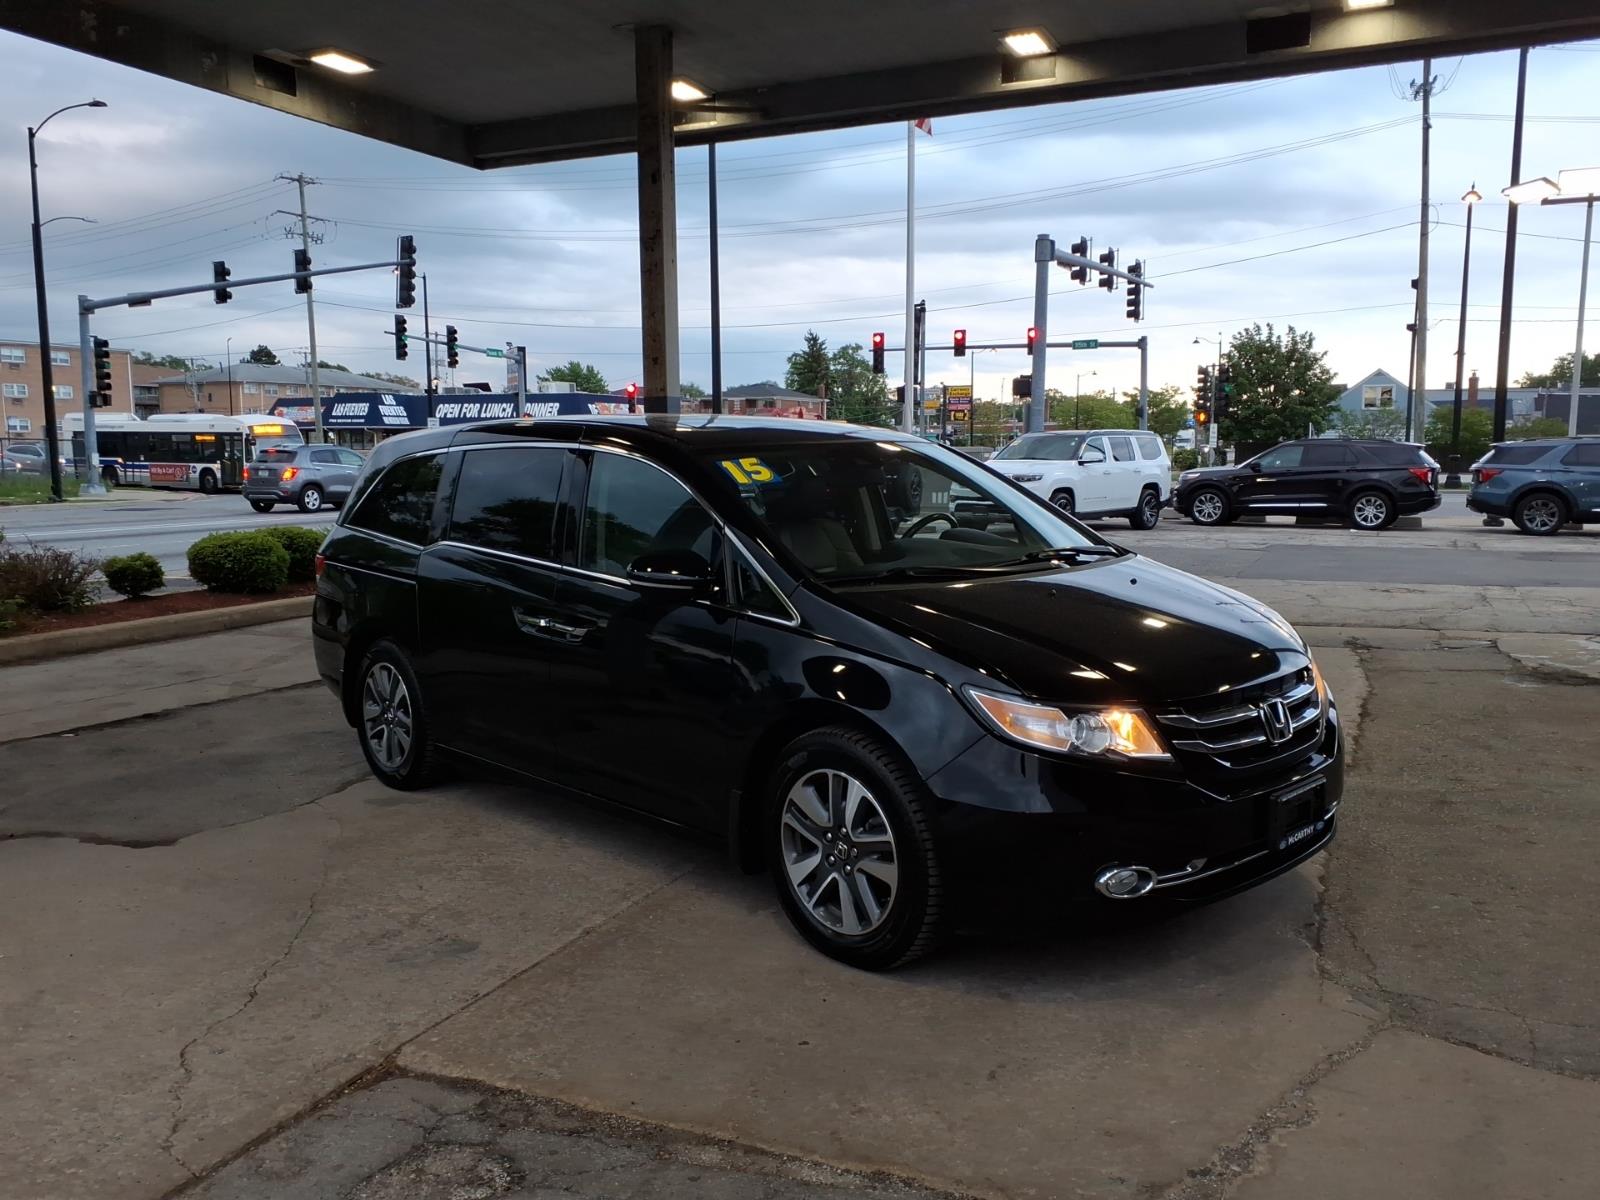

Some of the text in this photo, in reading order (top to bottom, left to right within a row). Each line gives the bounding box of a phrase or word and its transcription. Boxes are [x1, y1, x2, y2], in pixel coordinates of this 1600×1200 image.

[381, 394, 396, 405] LAS
[332, 403, 346, 416] LAS
[345, 403, 370, 416] FUENTES
[378, 405, 407, 416] FUENTES
[435, 403, 461, 418] OPEN
[460, 403, 481, 418] FOR
[480, 403, 514, 418] LUNCH
[525, 402, 560, 416] DINNER
[721, 457, 774, 484] 15
[1288, 825, 1315, 846] McCARTHY
